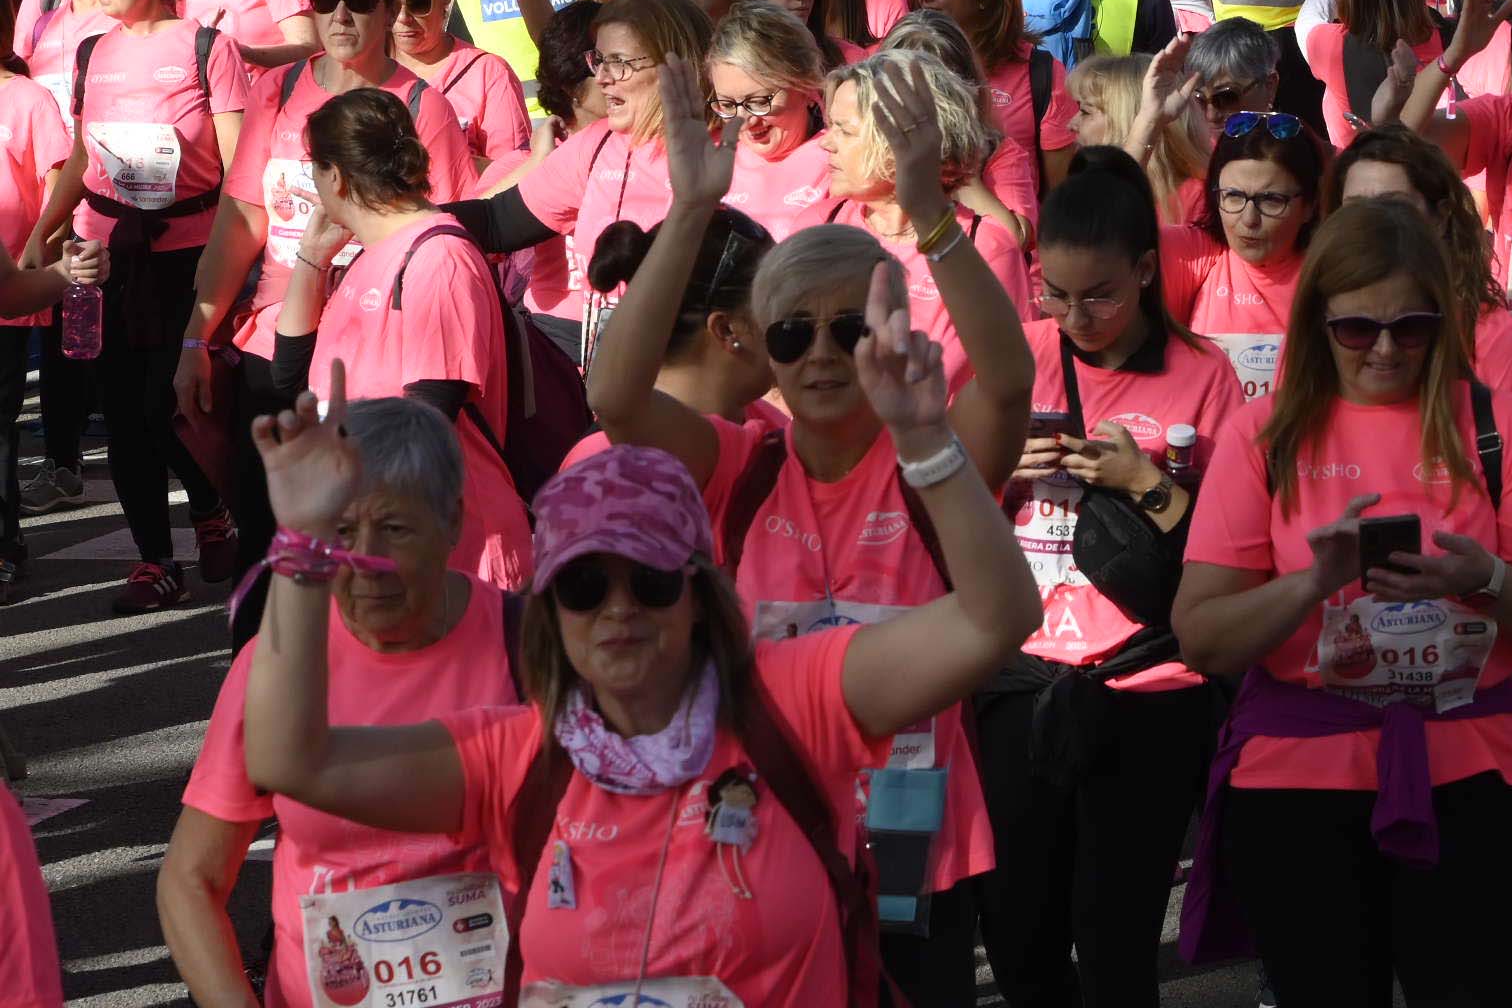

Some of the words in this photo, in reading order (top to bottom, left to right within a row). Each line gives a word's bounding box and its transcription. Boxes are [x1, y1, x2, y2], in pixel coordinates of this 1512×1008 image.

[1243, 380, 1271, 398] 01
[1045, 542, 1058, 553] DE
[1060, 543, 1071, 553] LA
[1376, 612, 1442, 629] ASTURIANA
[1381, 644, 1440, 666] 016
[448, 890, 488, 907] SUMA
[361, 912, 437, 936] ASTURIANA
[373, 951, 443, 985] 016
[385, 985, 439, 1008] 31761
